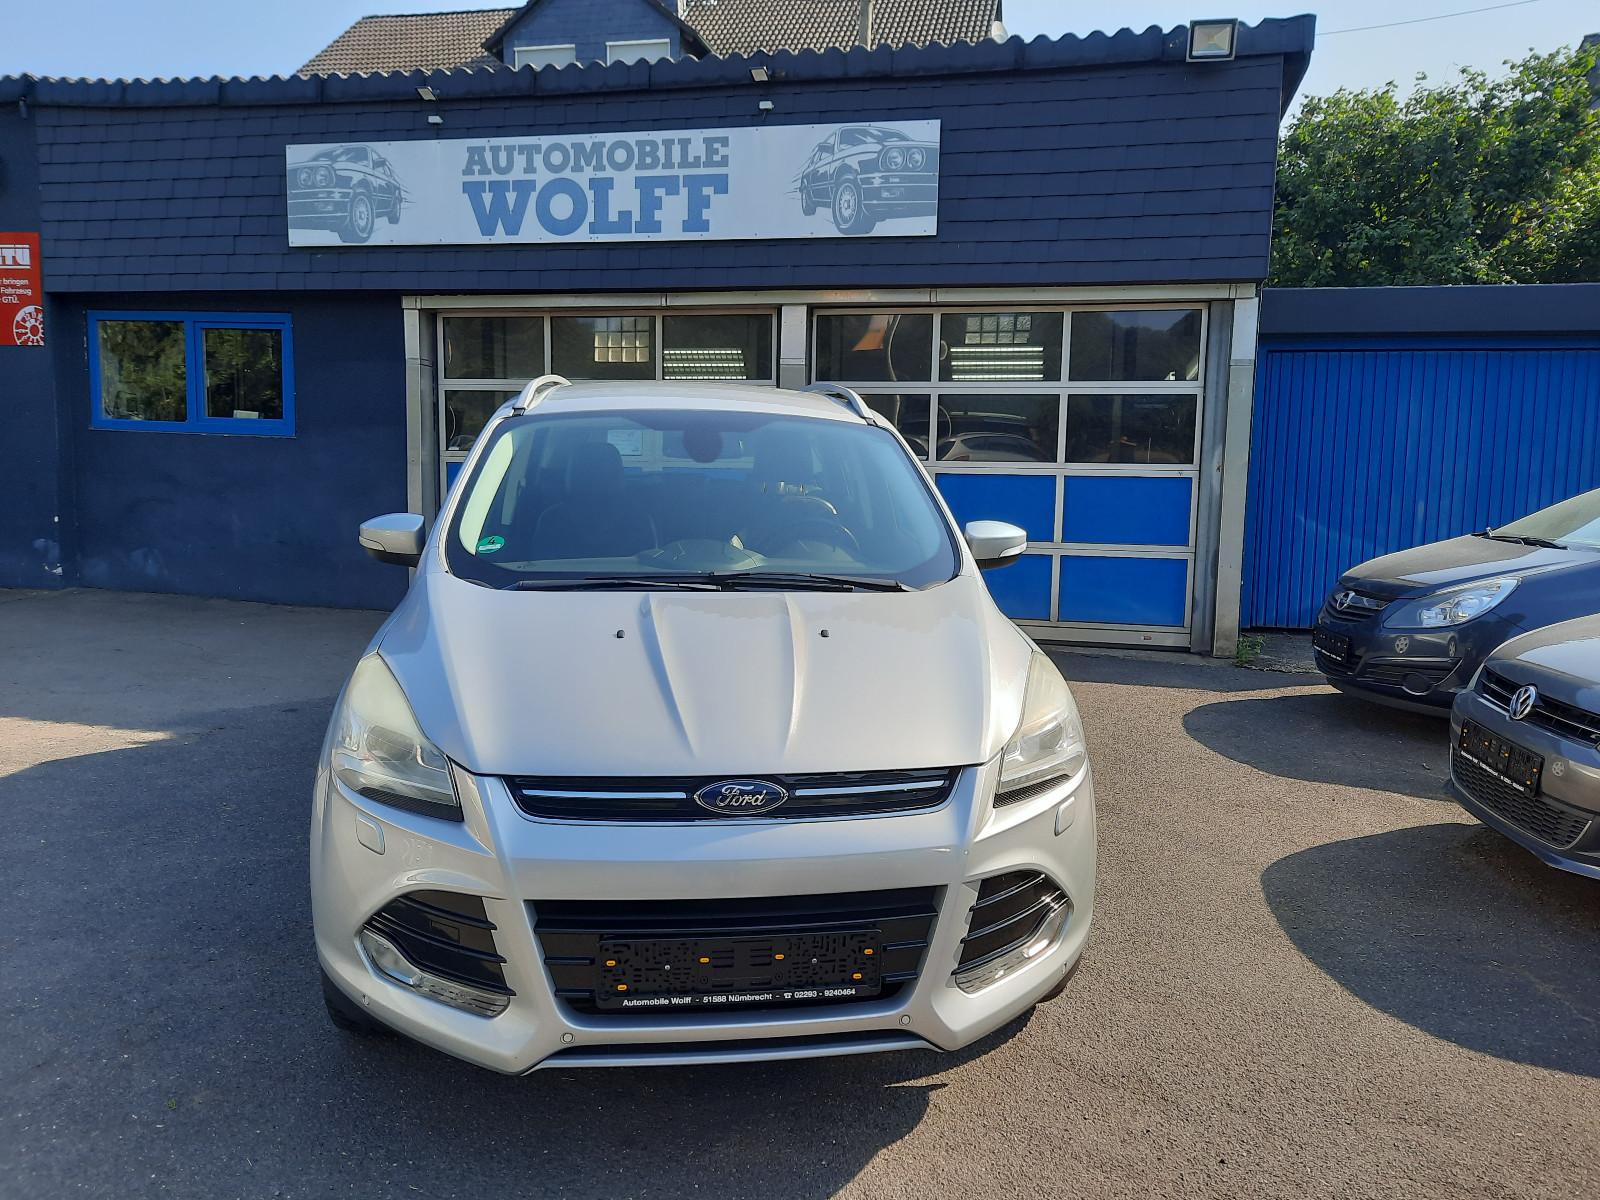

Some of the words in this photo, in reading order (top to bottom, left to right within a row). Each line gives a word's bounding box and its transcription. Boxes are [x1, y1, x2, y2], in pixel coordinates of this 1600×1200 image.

[462, 136, 729, 176] AUTOMOBILE
[462, 174, 729, 236] WOLFF
[0, 286, 32, 296] Fahrzeug
[2, 277, 29, 287] bringen
[716, 784, 767, 807] Ford
[622, 997, 670, 1007] Automobile
[671, 996, 693, 1005] Wolff
[702, 995, 728, 1003] 51588
[728, 993, 773, 1002] Nümbrecht
[794, 989, 818, 999] 02293
